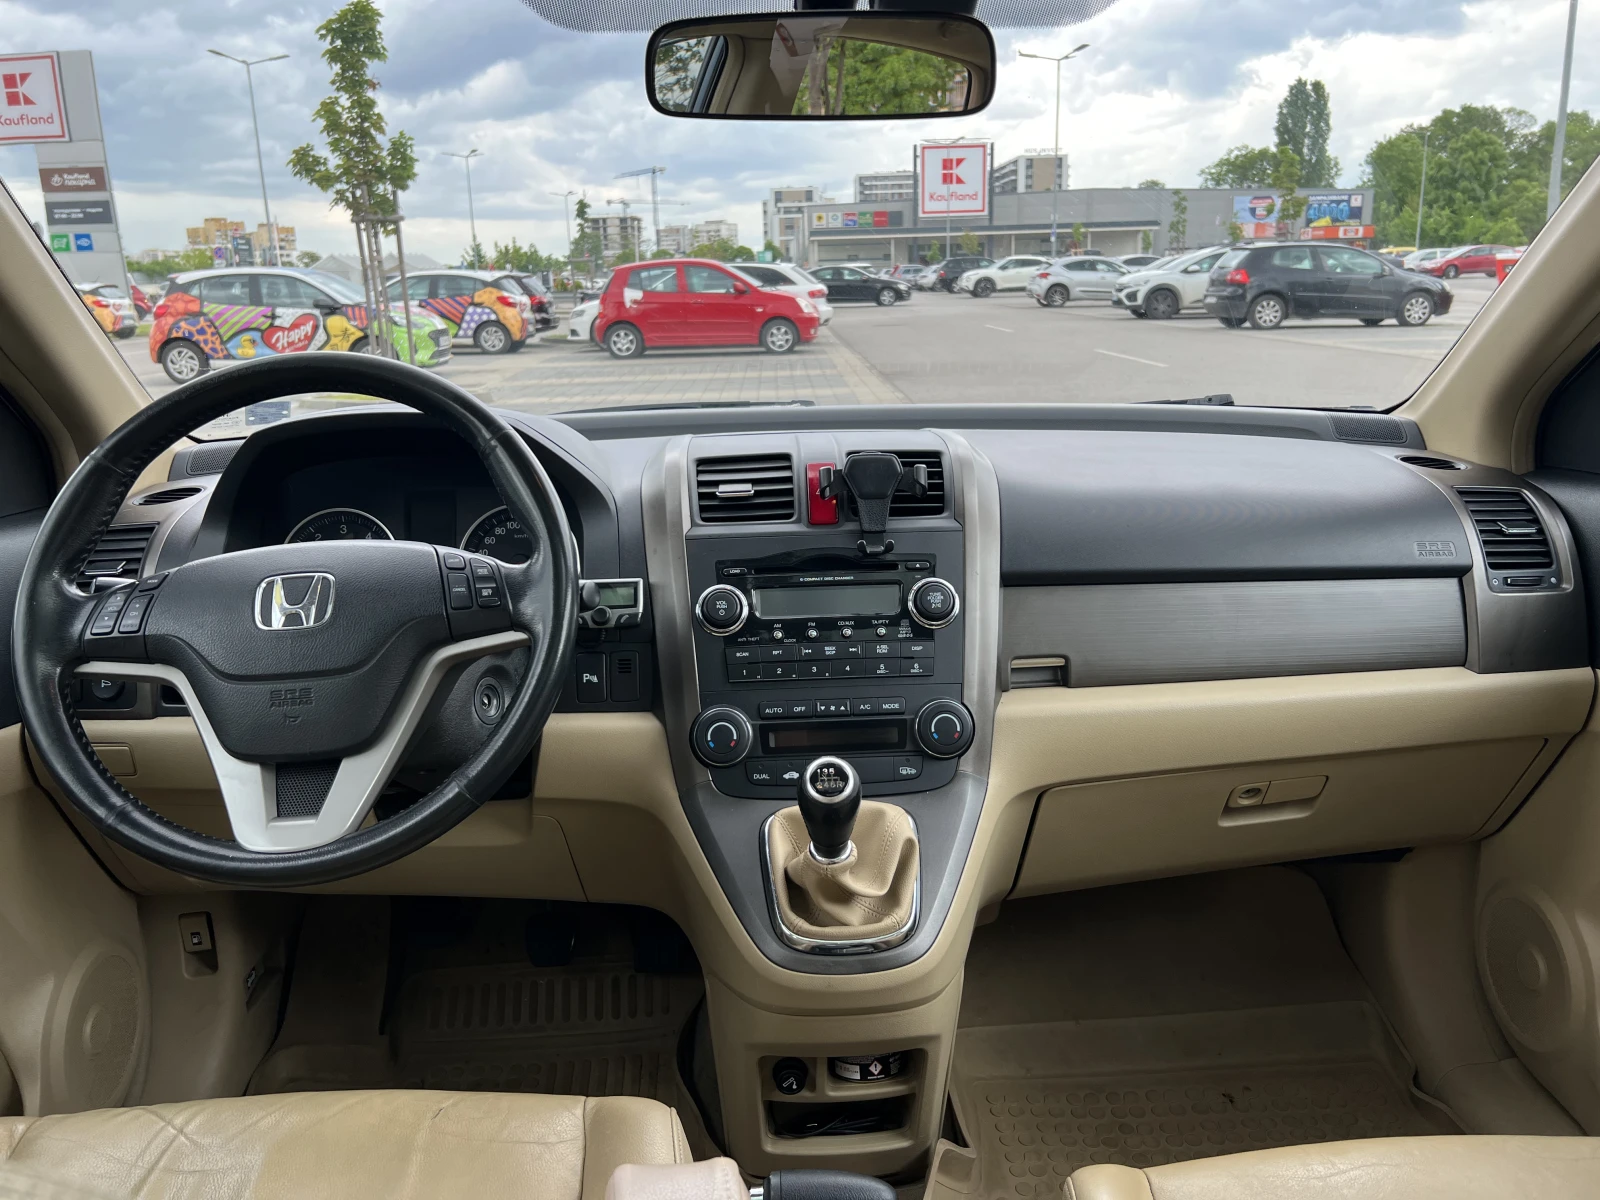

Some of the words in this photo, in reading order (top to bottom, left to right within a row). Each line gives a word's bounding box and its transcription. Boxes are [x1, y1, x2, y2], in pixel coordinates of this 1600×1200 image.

[928, 191, 979, 202] Kaufland
[271, 319, 314, 351] Happy
[339, 524, 348, 534] 3
[506, 521, 521, 529] 100
[494, 527, 506, 535] 80
[314, 533, 322, 541] 2
[484, 536, 496, 545] 60
[1416, 542, 1452, 550] SRS
[269, 687, 314, 700] SRS
[269, 699, 314, 709] AIRBAG
[882, 702, 900, 710] MODE
[822, 767, 828, 775] 3
[828, 767, 835, 775] 5
[836, 780, 843, 788] R
